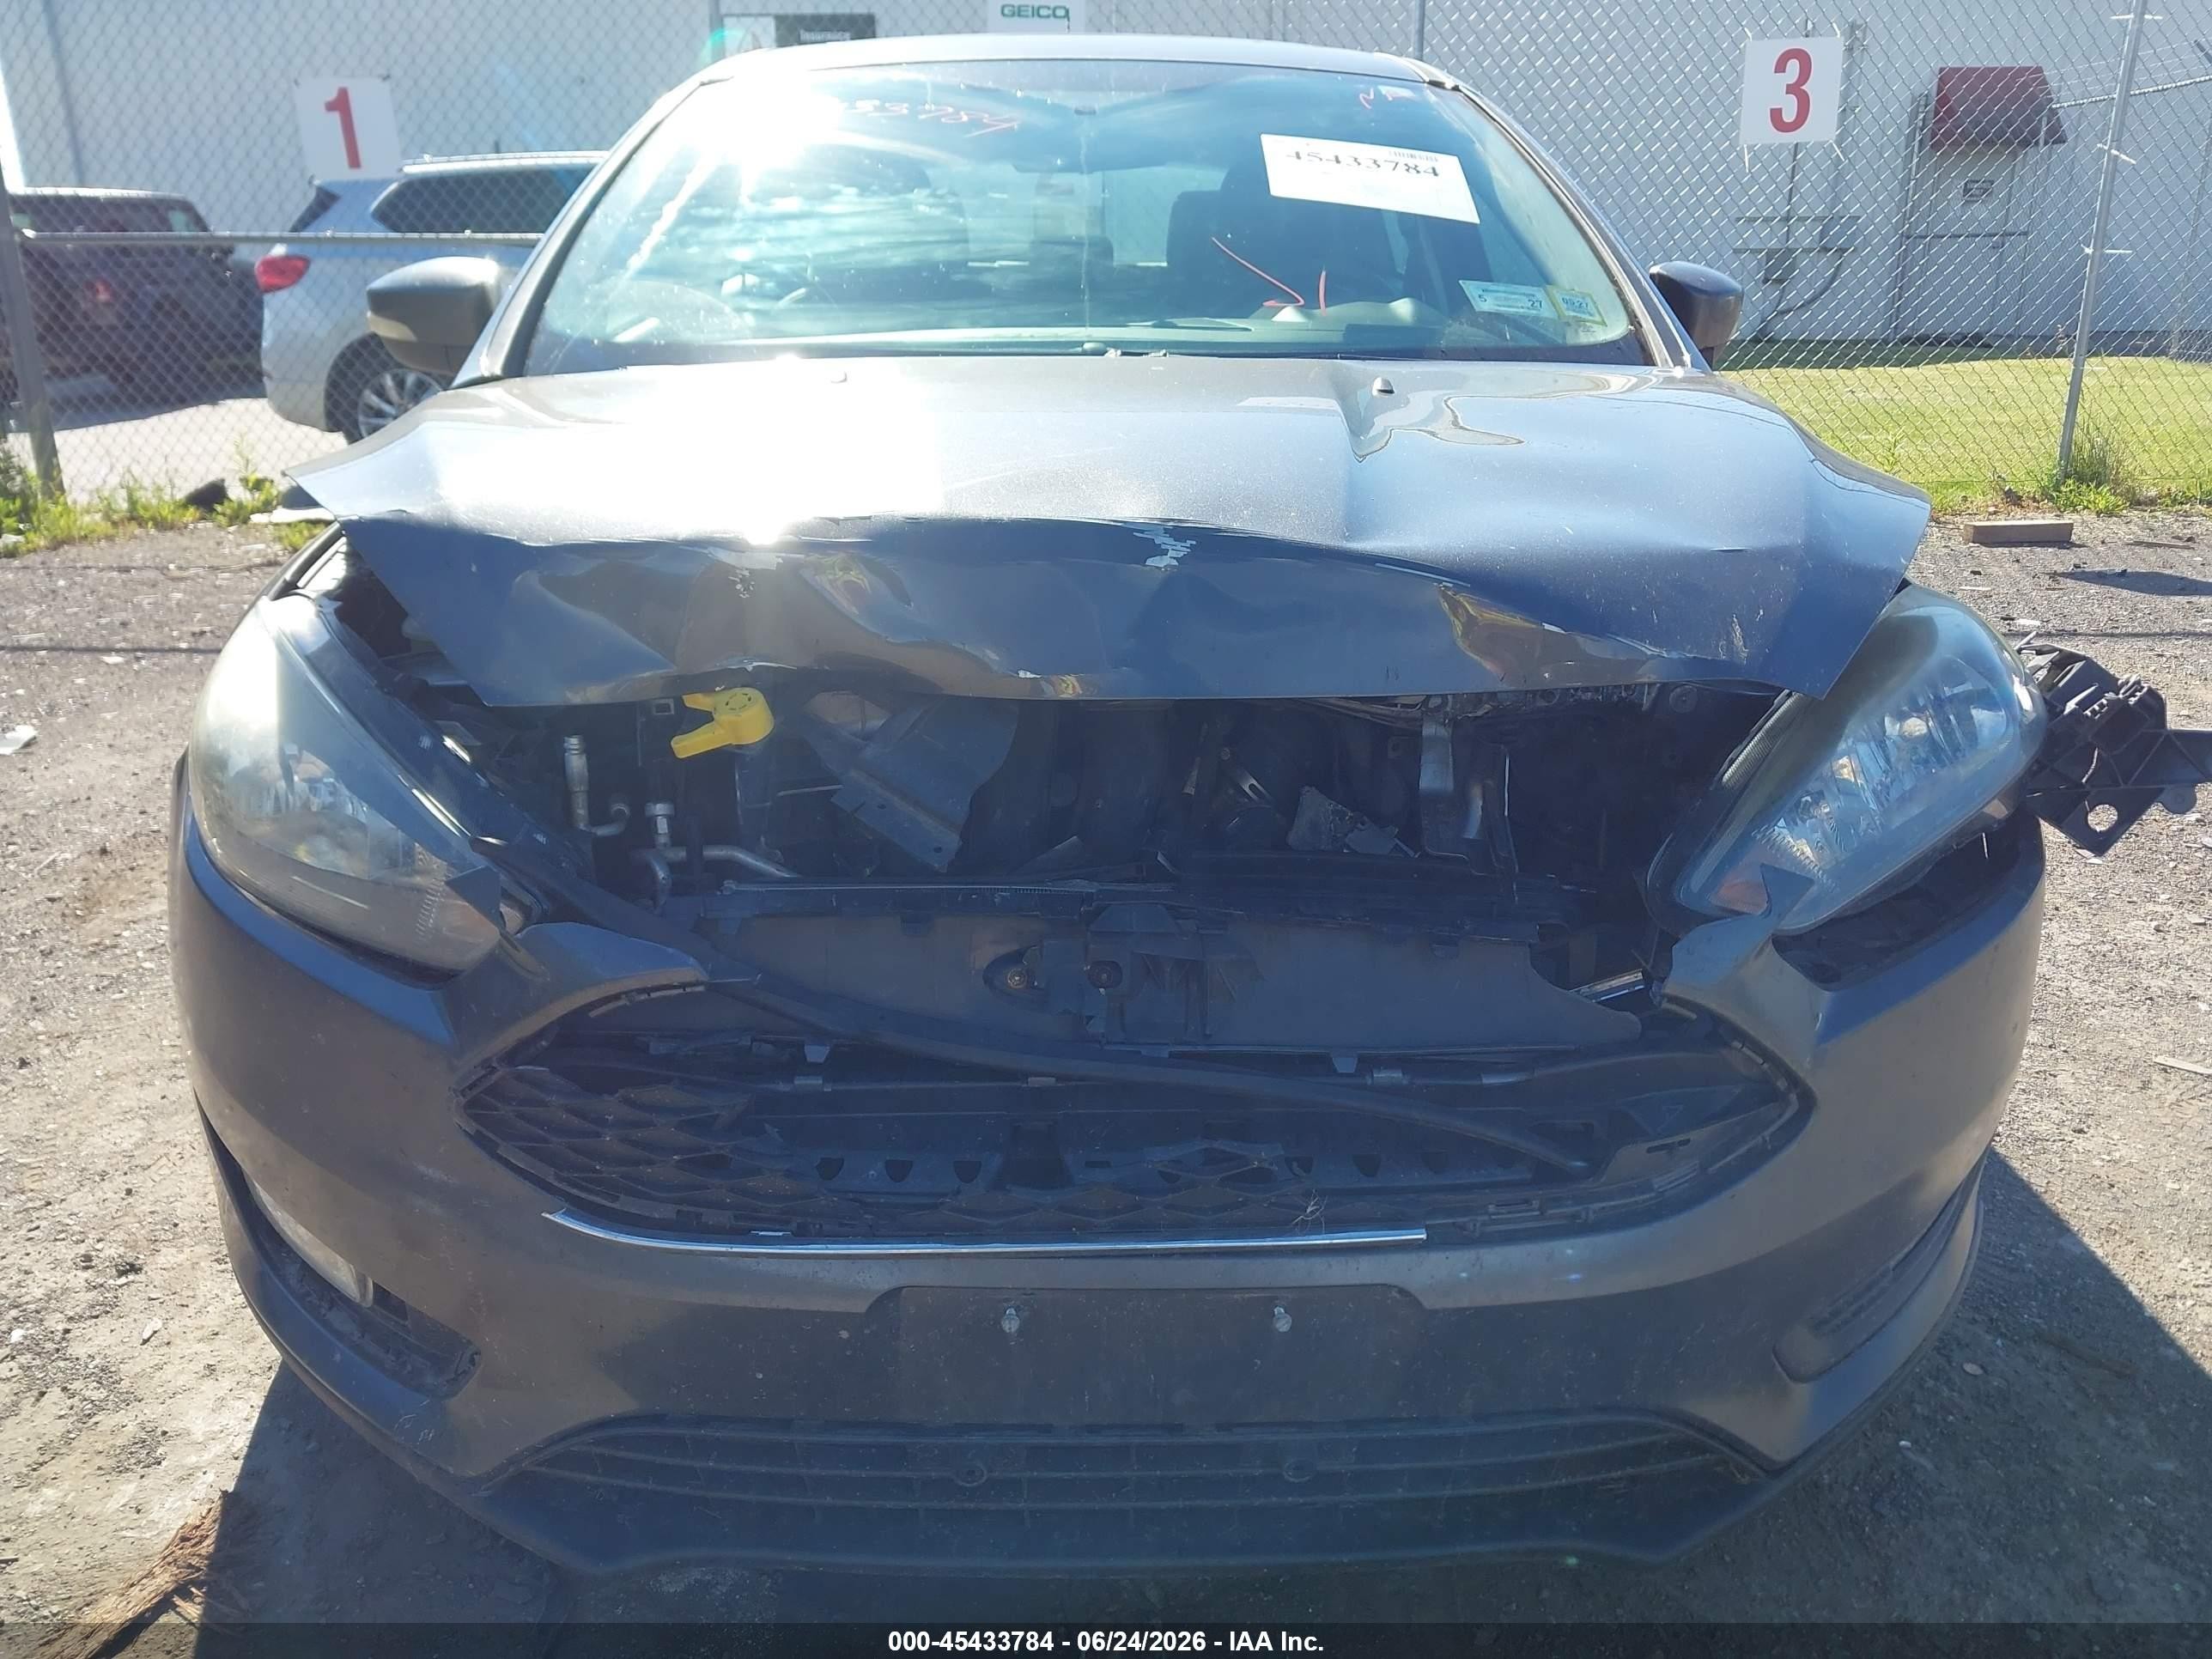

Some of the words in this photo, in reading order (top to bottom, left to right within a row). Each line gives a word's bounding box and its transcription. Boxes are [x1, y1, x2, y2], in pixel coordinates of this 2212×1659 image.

[1001, 4, 1068, 18] GEICO
[1770, 48, 1812, 133] 3
[325, 87, 361, 168] 1
[1286, 150, 1439, 177] 45433784
[1528, 300, 1543, 309] 27
